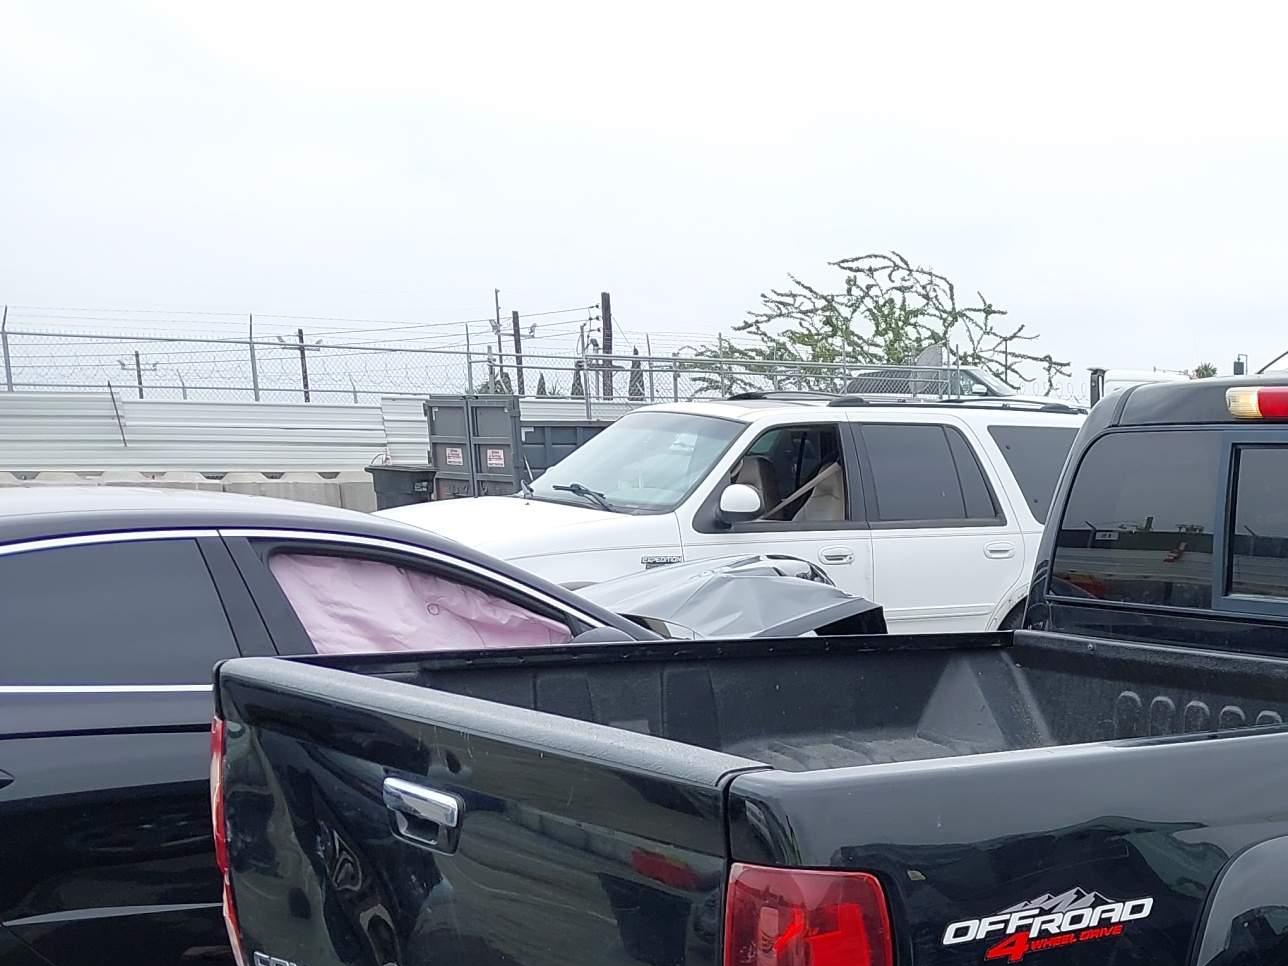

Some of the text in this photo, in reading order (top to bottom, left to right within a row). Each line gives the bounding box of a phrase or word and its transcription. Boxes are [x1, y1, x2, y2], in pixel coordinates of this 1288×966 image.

[943, 897, 1154, 945] OFFROAD
[984, 924, 1124, 963] 4 WHEEL DRIVE
